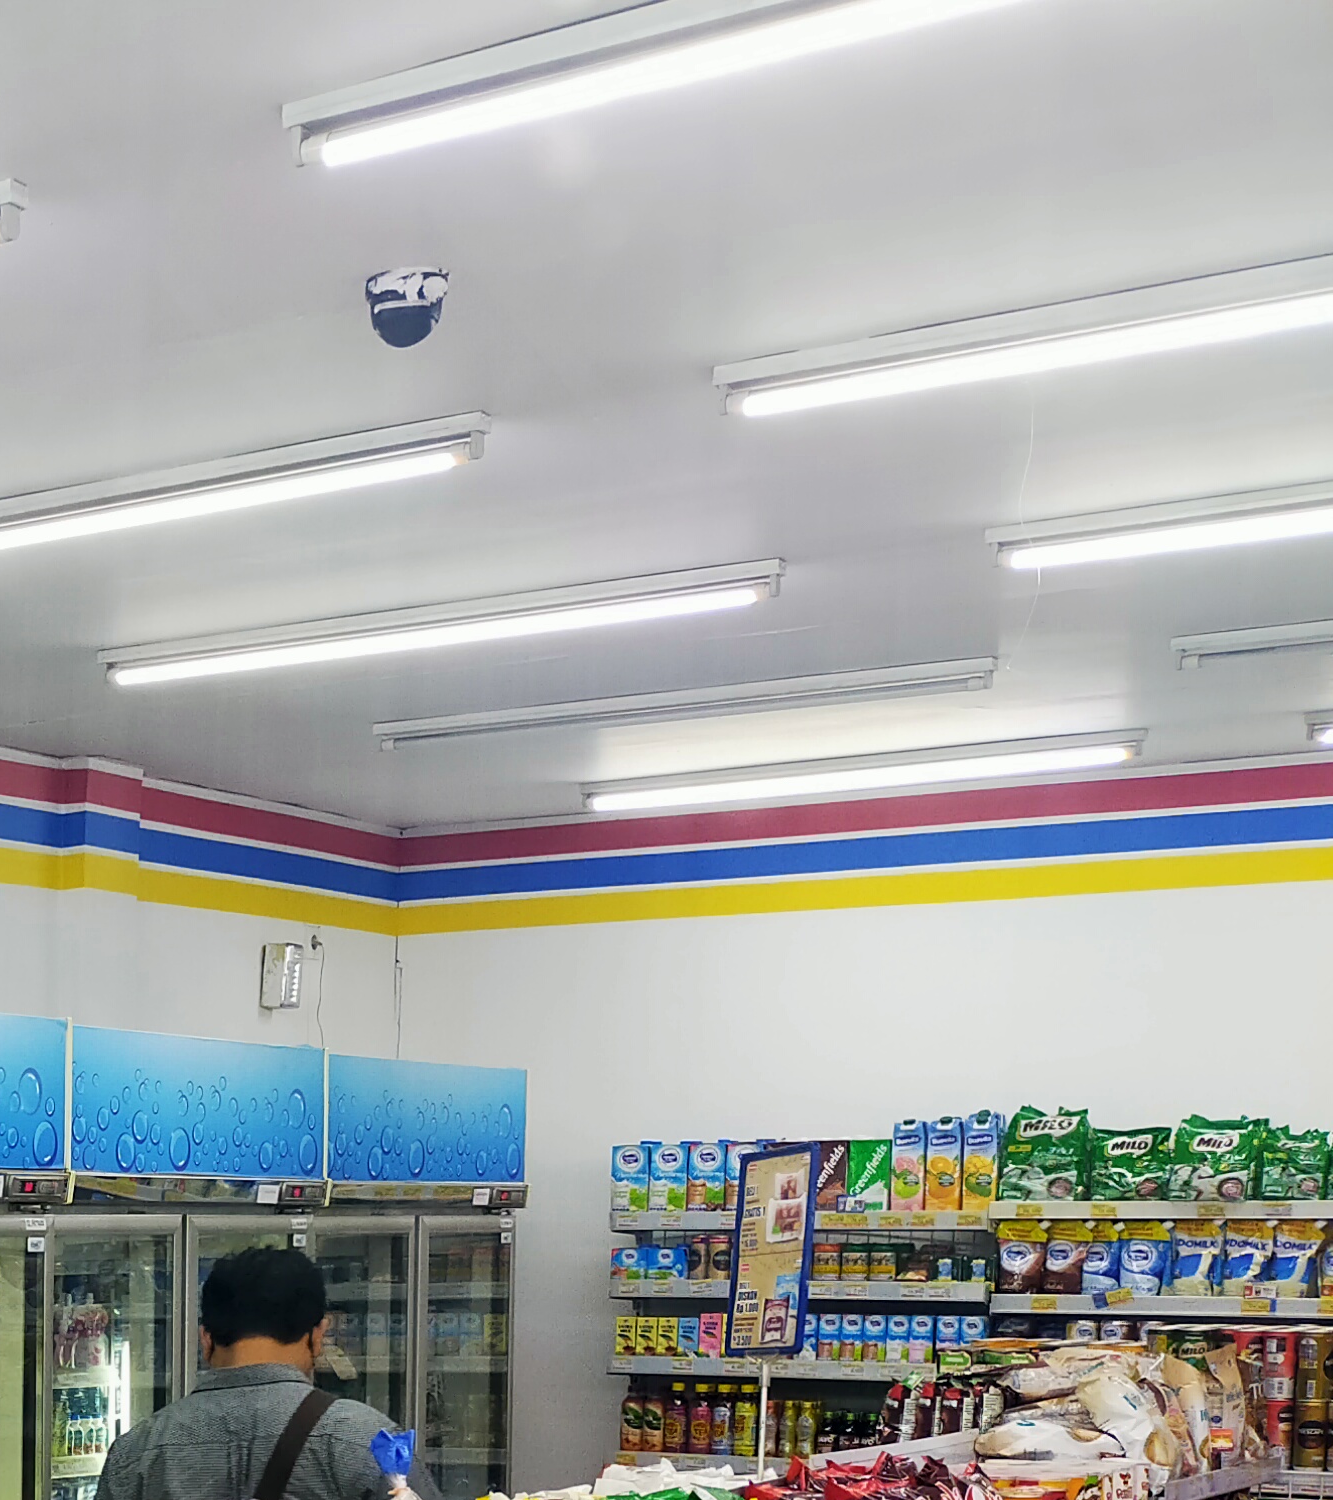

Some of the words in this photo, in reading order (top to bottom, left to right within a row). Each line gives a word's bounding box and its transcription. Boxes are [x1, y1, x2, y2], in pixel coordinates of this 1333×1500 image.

[1109, 1140, 1149, 1152] MILO
[1196, 1137, 1234, 1149] MILO
[817, 1144, 845, 1188] reenfields
[850, 1143, 888, 1195] Greenfields
